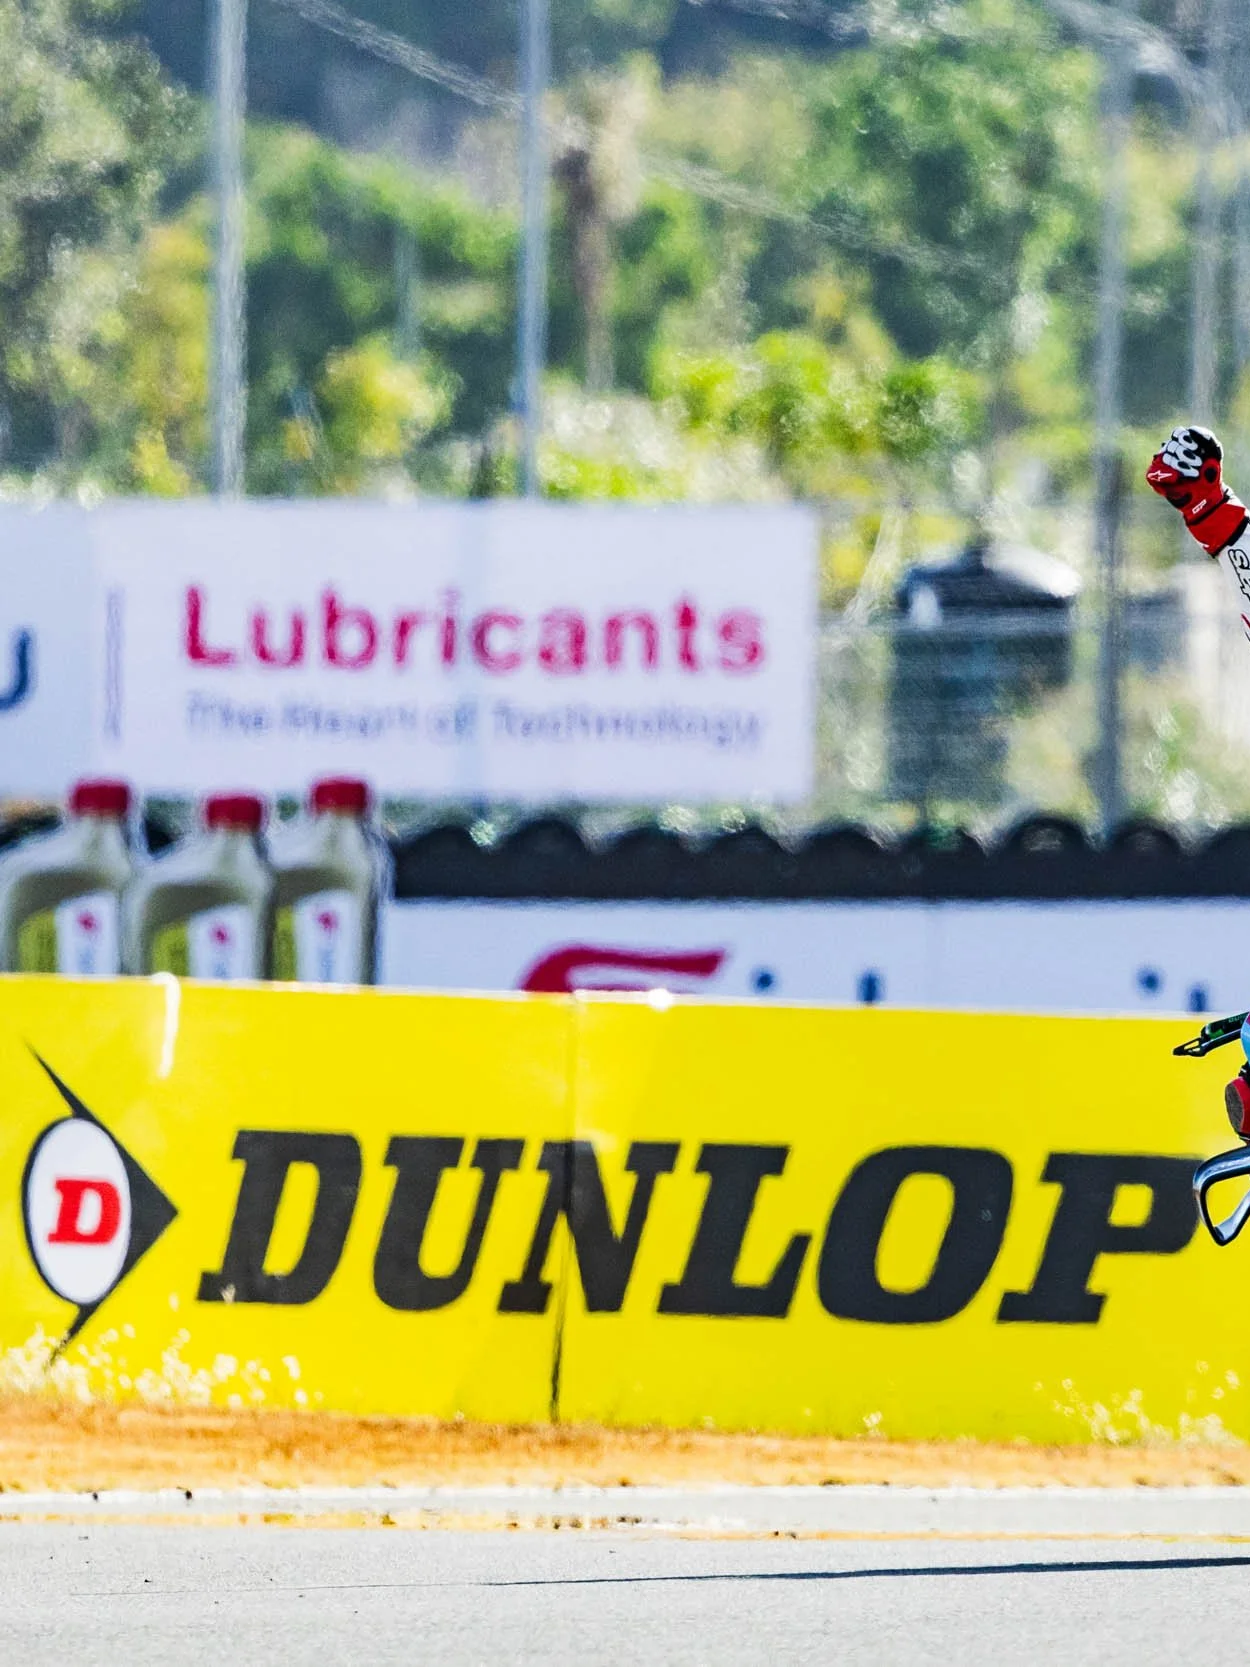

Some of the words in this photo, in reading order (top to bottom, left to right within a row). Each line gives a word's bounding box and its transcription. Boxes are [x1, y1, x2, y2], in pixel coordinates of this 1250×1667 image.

[182, 582, 765, 675] Lubricants
[48, 1178, 121, 1245] D
[195, 1129, 1204, 1324] DUNLOP
